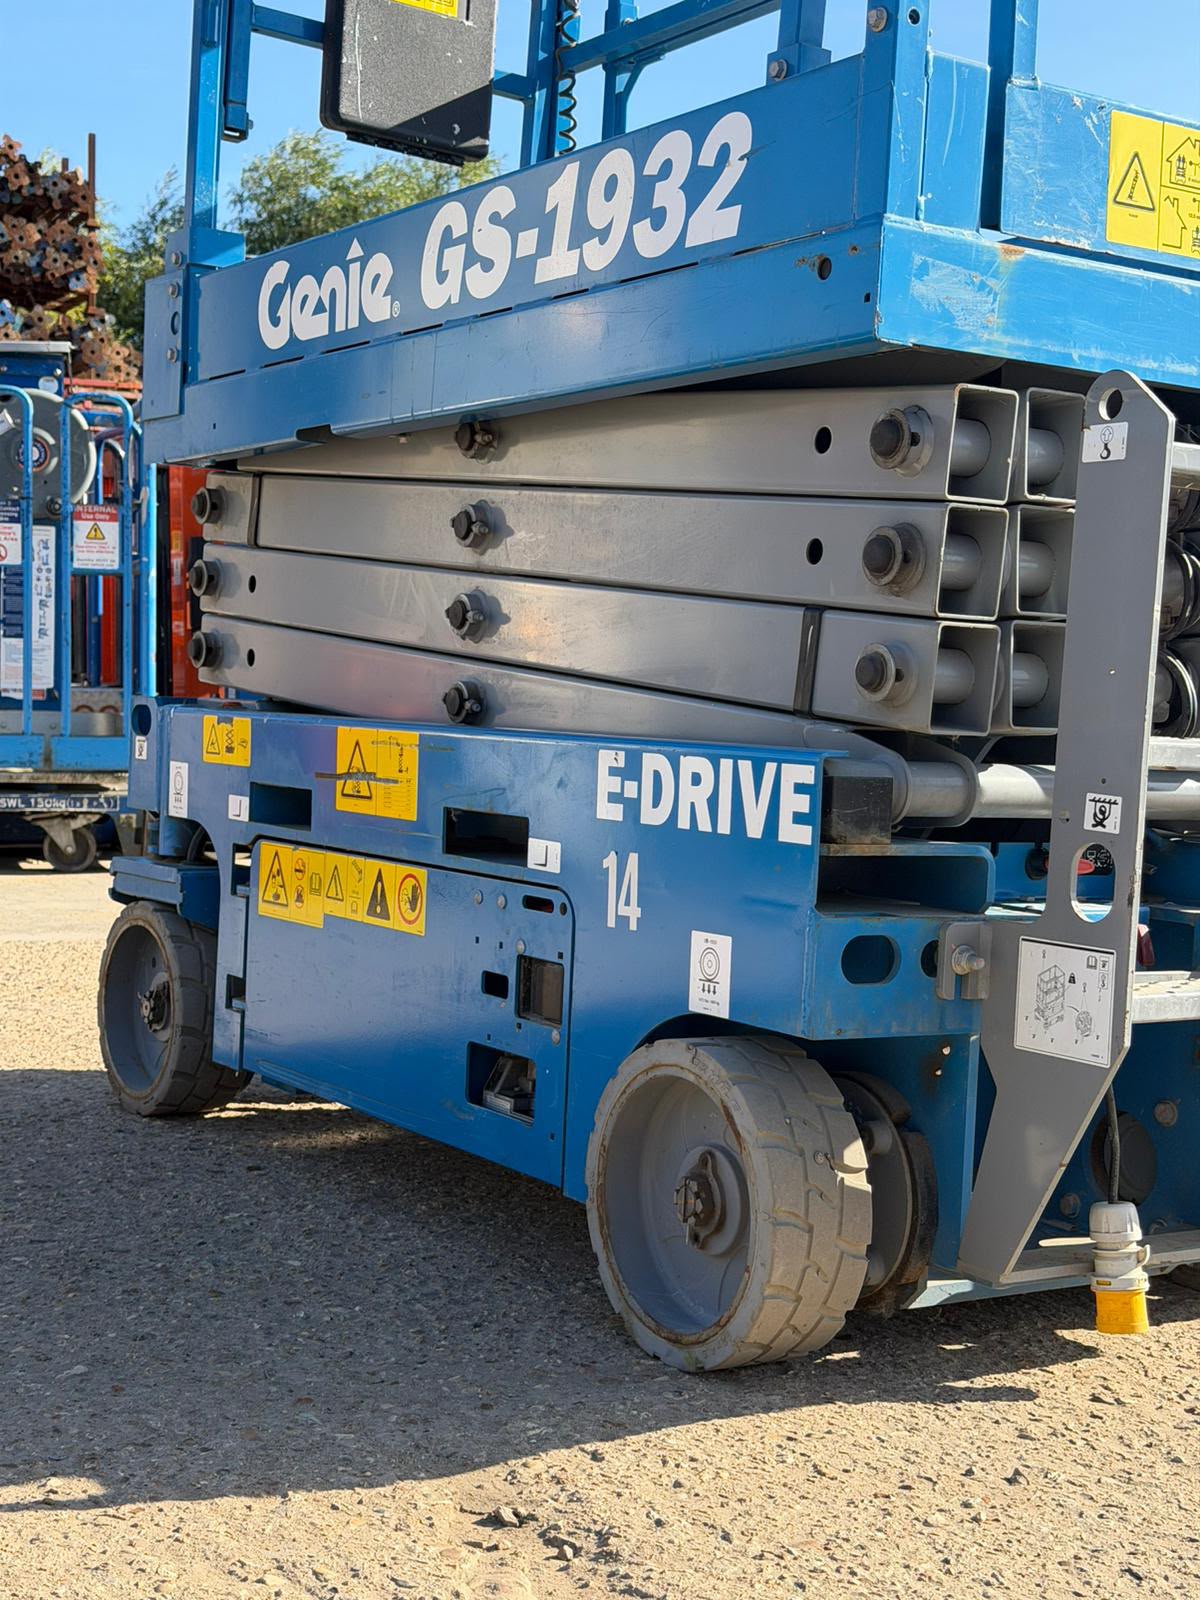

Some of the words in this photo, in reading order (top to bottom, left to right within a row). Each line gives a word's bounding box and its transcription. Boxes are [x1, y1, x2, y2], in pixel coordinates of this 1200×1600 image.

[258, 238, 393, 350] Genie
[420, 111, 754, 310] GS-1932
[596, 749, 815, 846] E-DRIVE
[602, 850, 642, 931] 14
